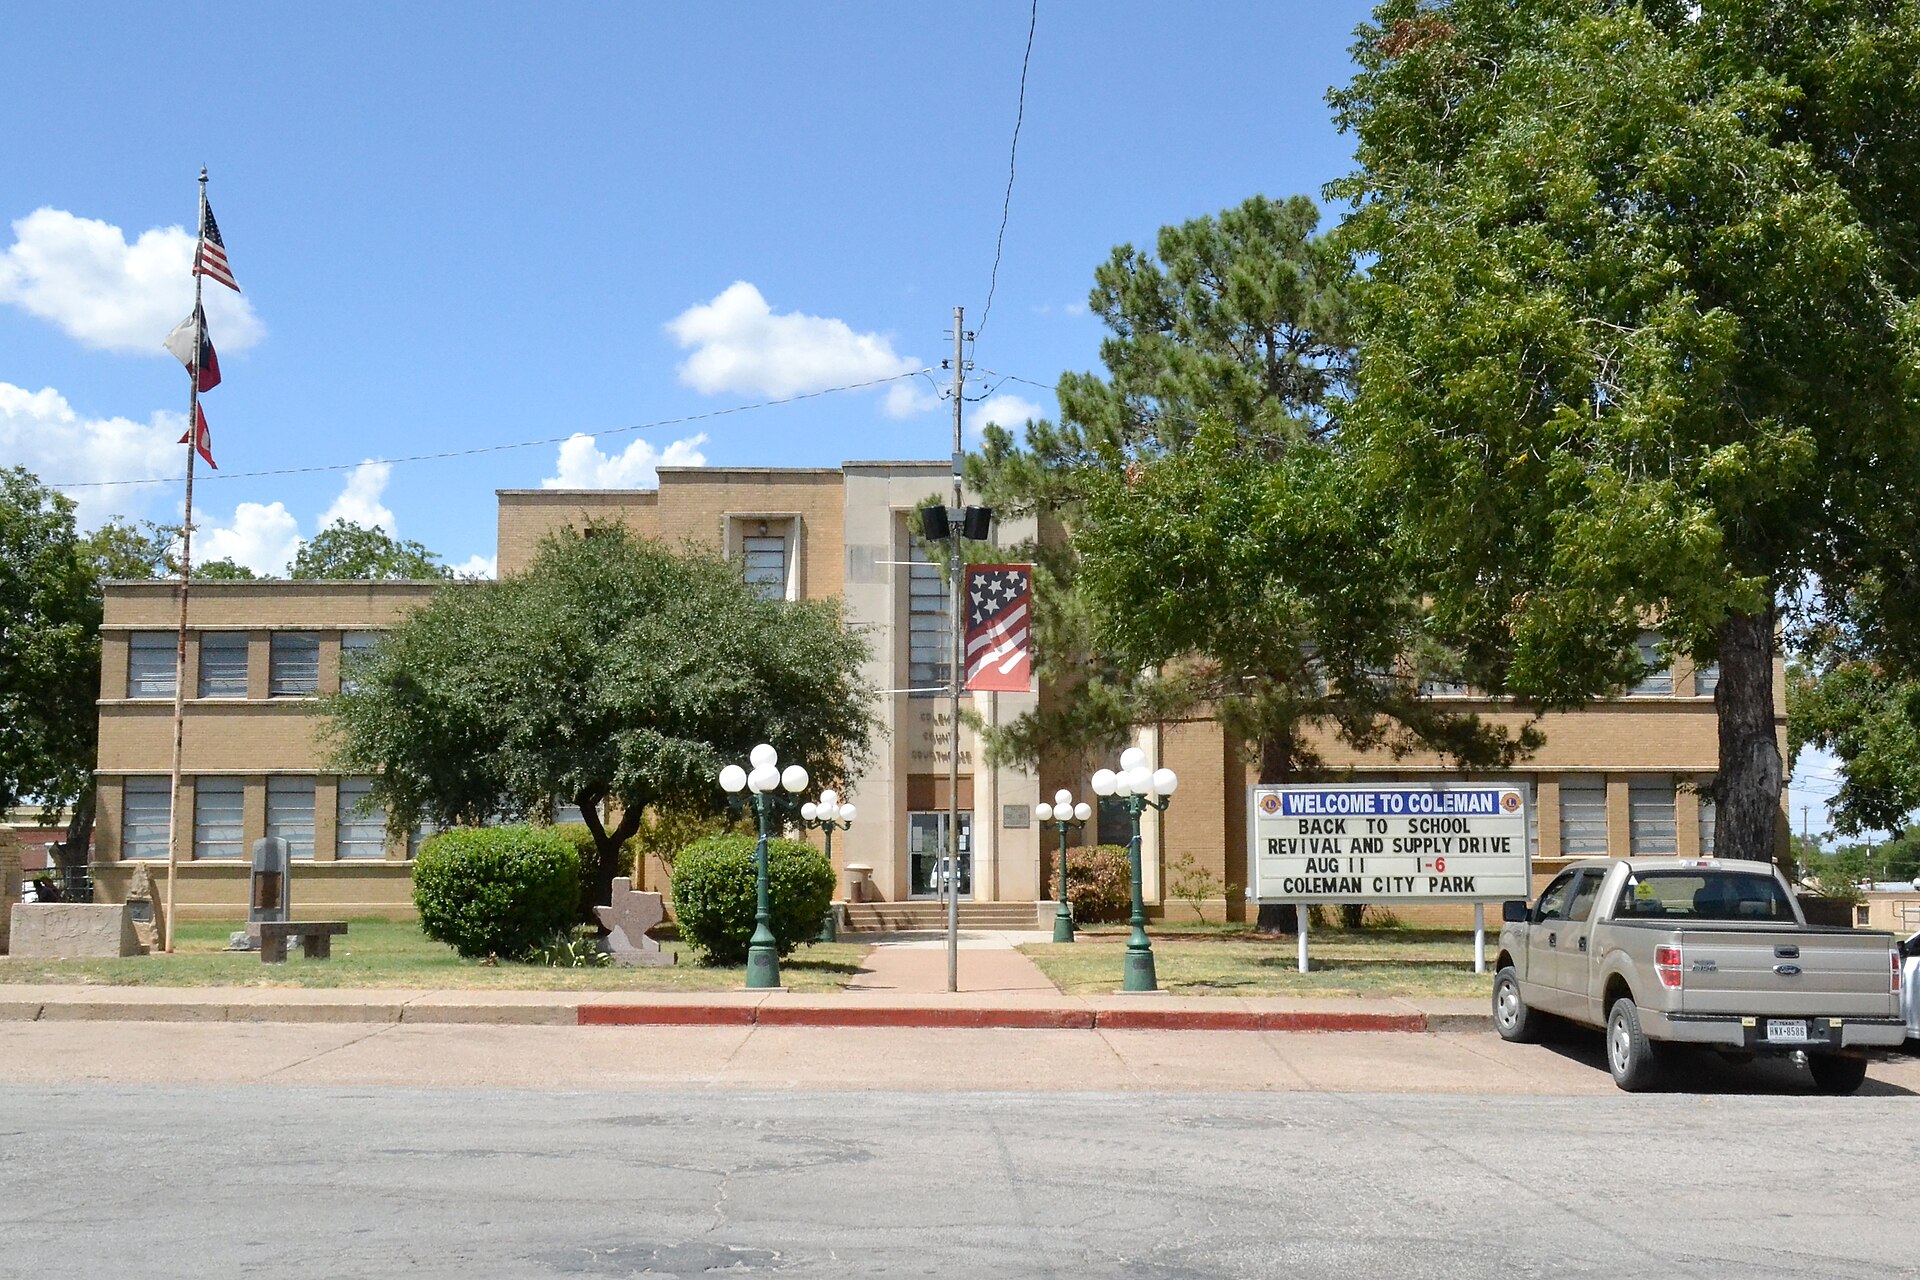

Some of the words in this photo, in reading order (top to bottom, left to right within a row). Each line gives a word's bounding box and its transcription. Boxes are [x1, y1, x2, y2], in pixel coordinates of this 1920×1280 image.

[1289, 794, 1375, 813] WELCOME
[1380, 794, 1404, 813] TO
[1408, 793, 1493, 813] COLEMAN
[1298, 818, 1346, 835] BACK
[1366, 818, 1388, 834] TO
[1408, 818, 1471, 834] SCHOOL
[1268, 838, 1342, 854] REVIVAL
[1350, 838, 1384, 854] AND
[1392, 837, 1452, 853] SUPPLY
[1459, 837, 1511, 853] DRIVE
[1305, 858, 1339, 873] AUG
[1283, 877, 1362, 893] COLEMAN
[1373, 877, 1415, 893] CITY
[1428, 876, 1476, 893] PARK
